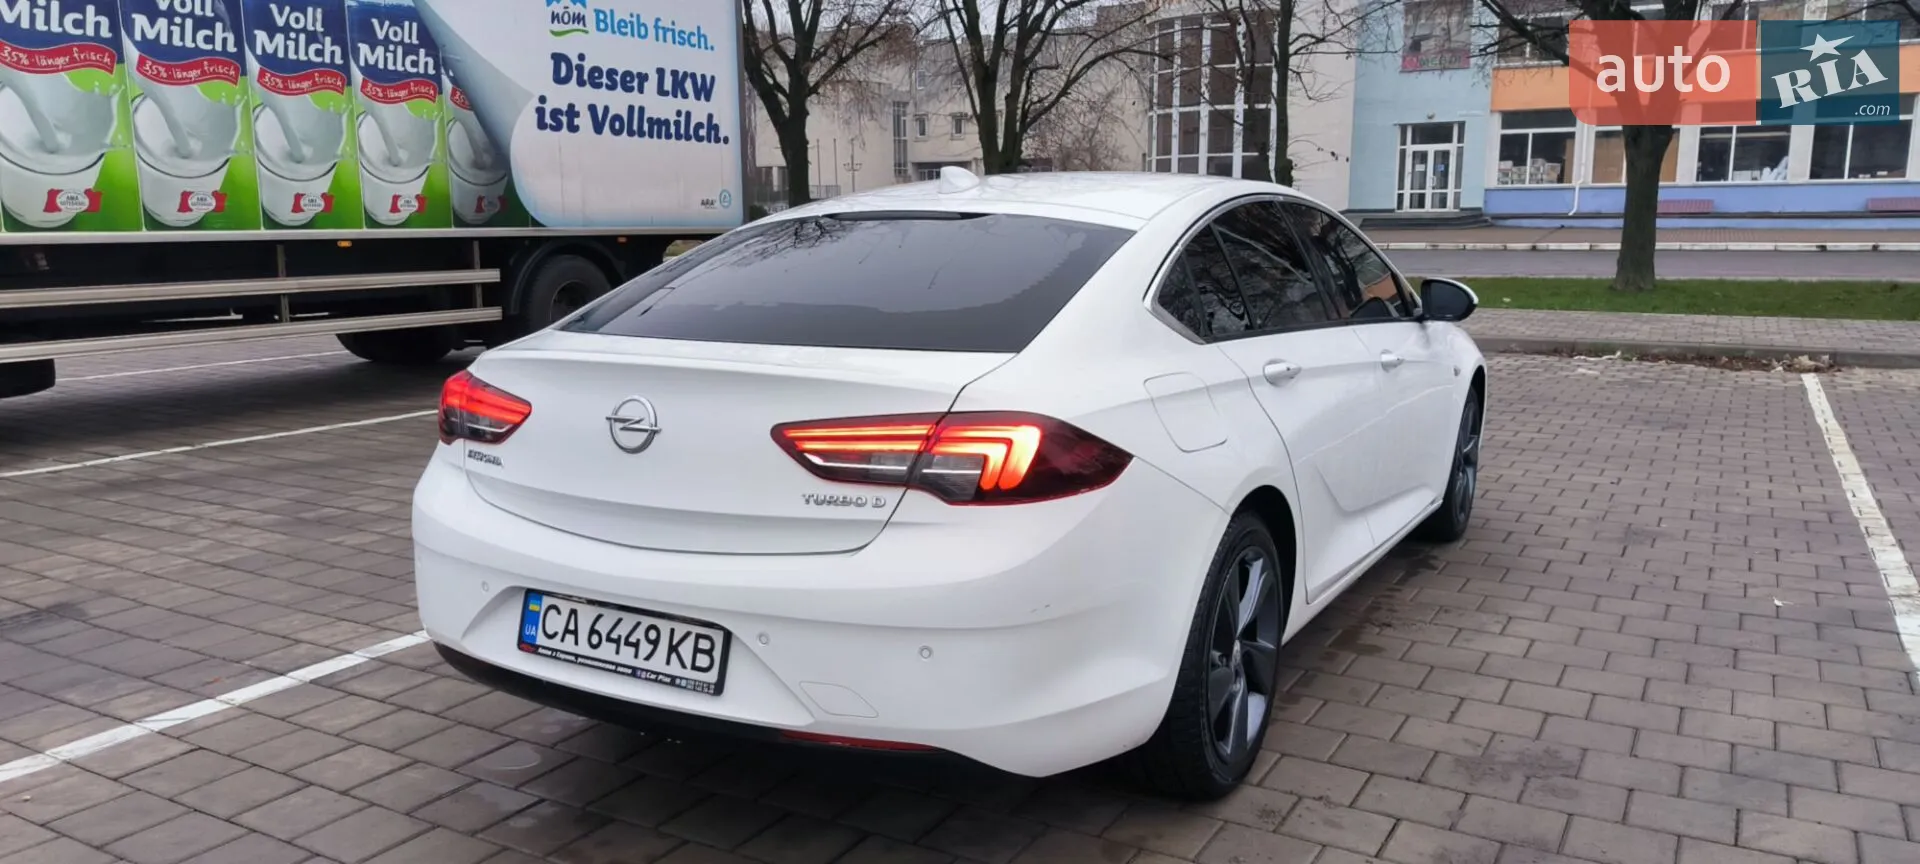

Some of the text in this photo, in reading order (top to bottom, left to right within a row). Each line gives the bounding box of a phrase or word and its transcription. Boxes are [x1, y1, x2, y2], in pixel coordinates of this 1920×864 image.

[0, 0, 112, 38] Milch
[131, 13, 238, 53] Milch
[269, 3, 324, 32] Voll
[371, 18, 419, 44] Voll
[594, 8, 716, 52] Bleib frisch.
[254, 29, 344, 65] Milch
[357, 43, 436, 75] Milch
[550, 52, 716, 102] Dieser LKW
[536, 95, 730, 145] ist Vollmilch.
[802, 493, 886, 508] TURBO D
[525, 623, 537, 637] UA
